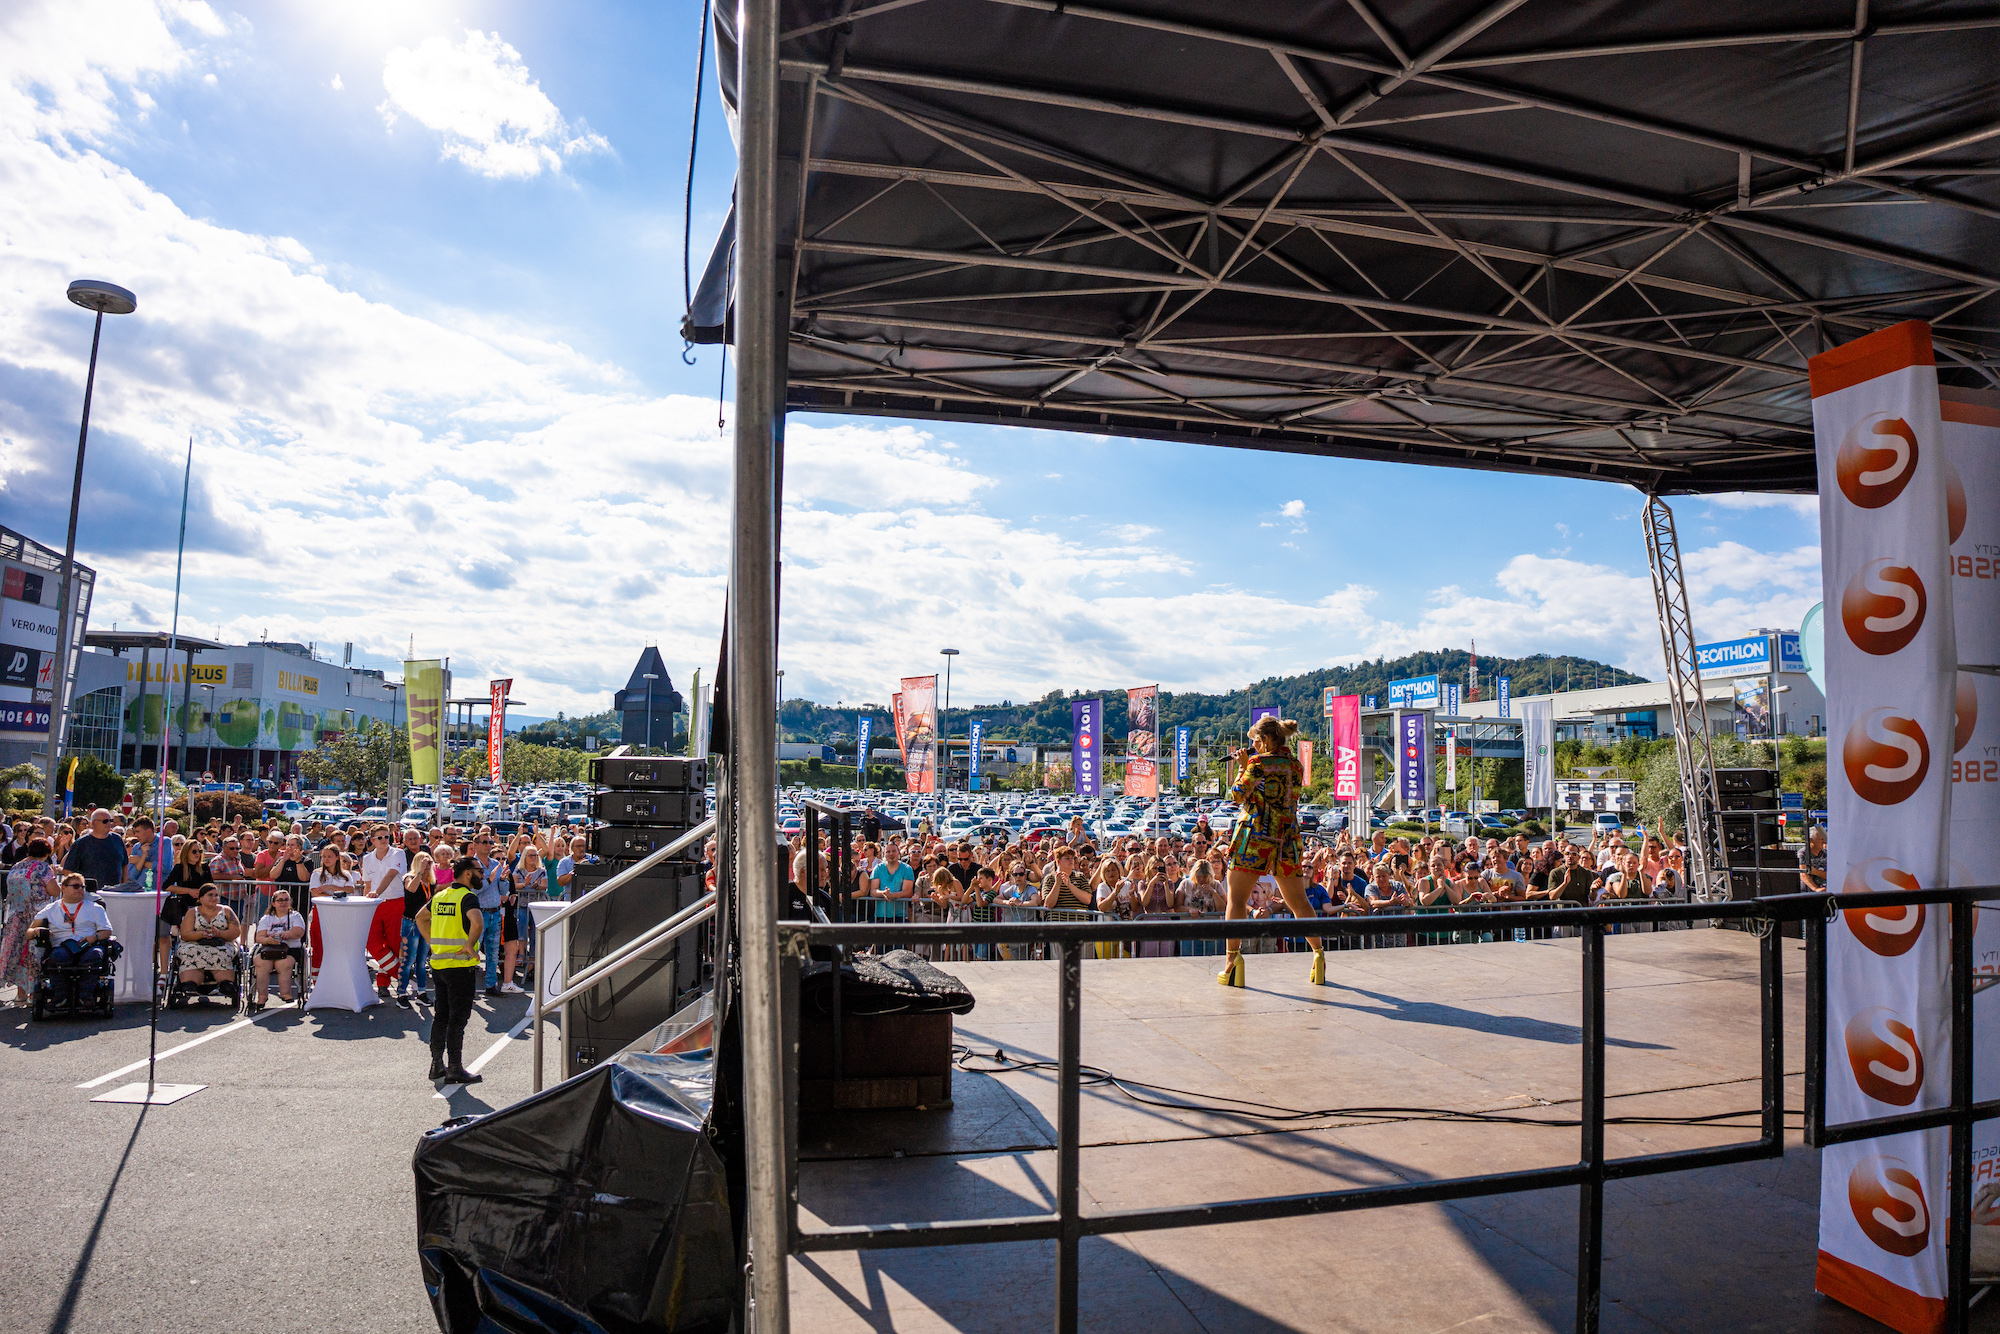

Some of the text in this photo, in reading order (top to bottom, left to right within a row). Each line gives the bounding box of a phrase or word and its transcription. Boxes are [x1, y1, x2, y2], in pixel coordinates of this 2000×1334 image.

[12, 618, 58, 636] VERO MOD
[7, 651, 28, 673] JD
[1696, 641, 1764, 665] DECATHLON
[127, 662, 223, 683] BILLA PLUS
[1748, 664, 1764, 672] SPORT
[278, 669, 318, 693] BILLA PLUS
[1391, 680, 1435, 699] DECATHLON
[1500, 679, 1508, 718] DECATHLON
[25, 712, 33, 724] 4
[1180, 729, 1188, 778] DECATHLON
[462, 788, 468, 799] P
[626, 804, 632, 812] 8
